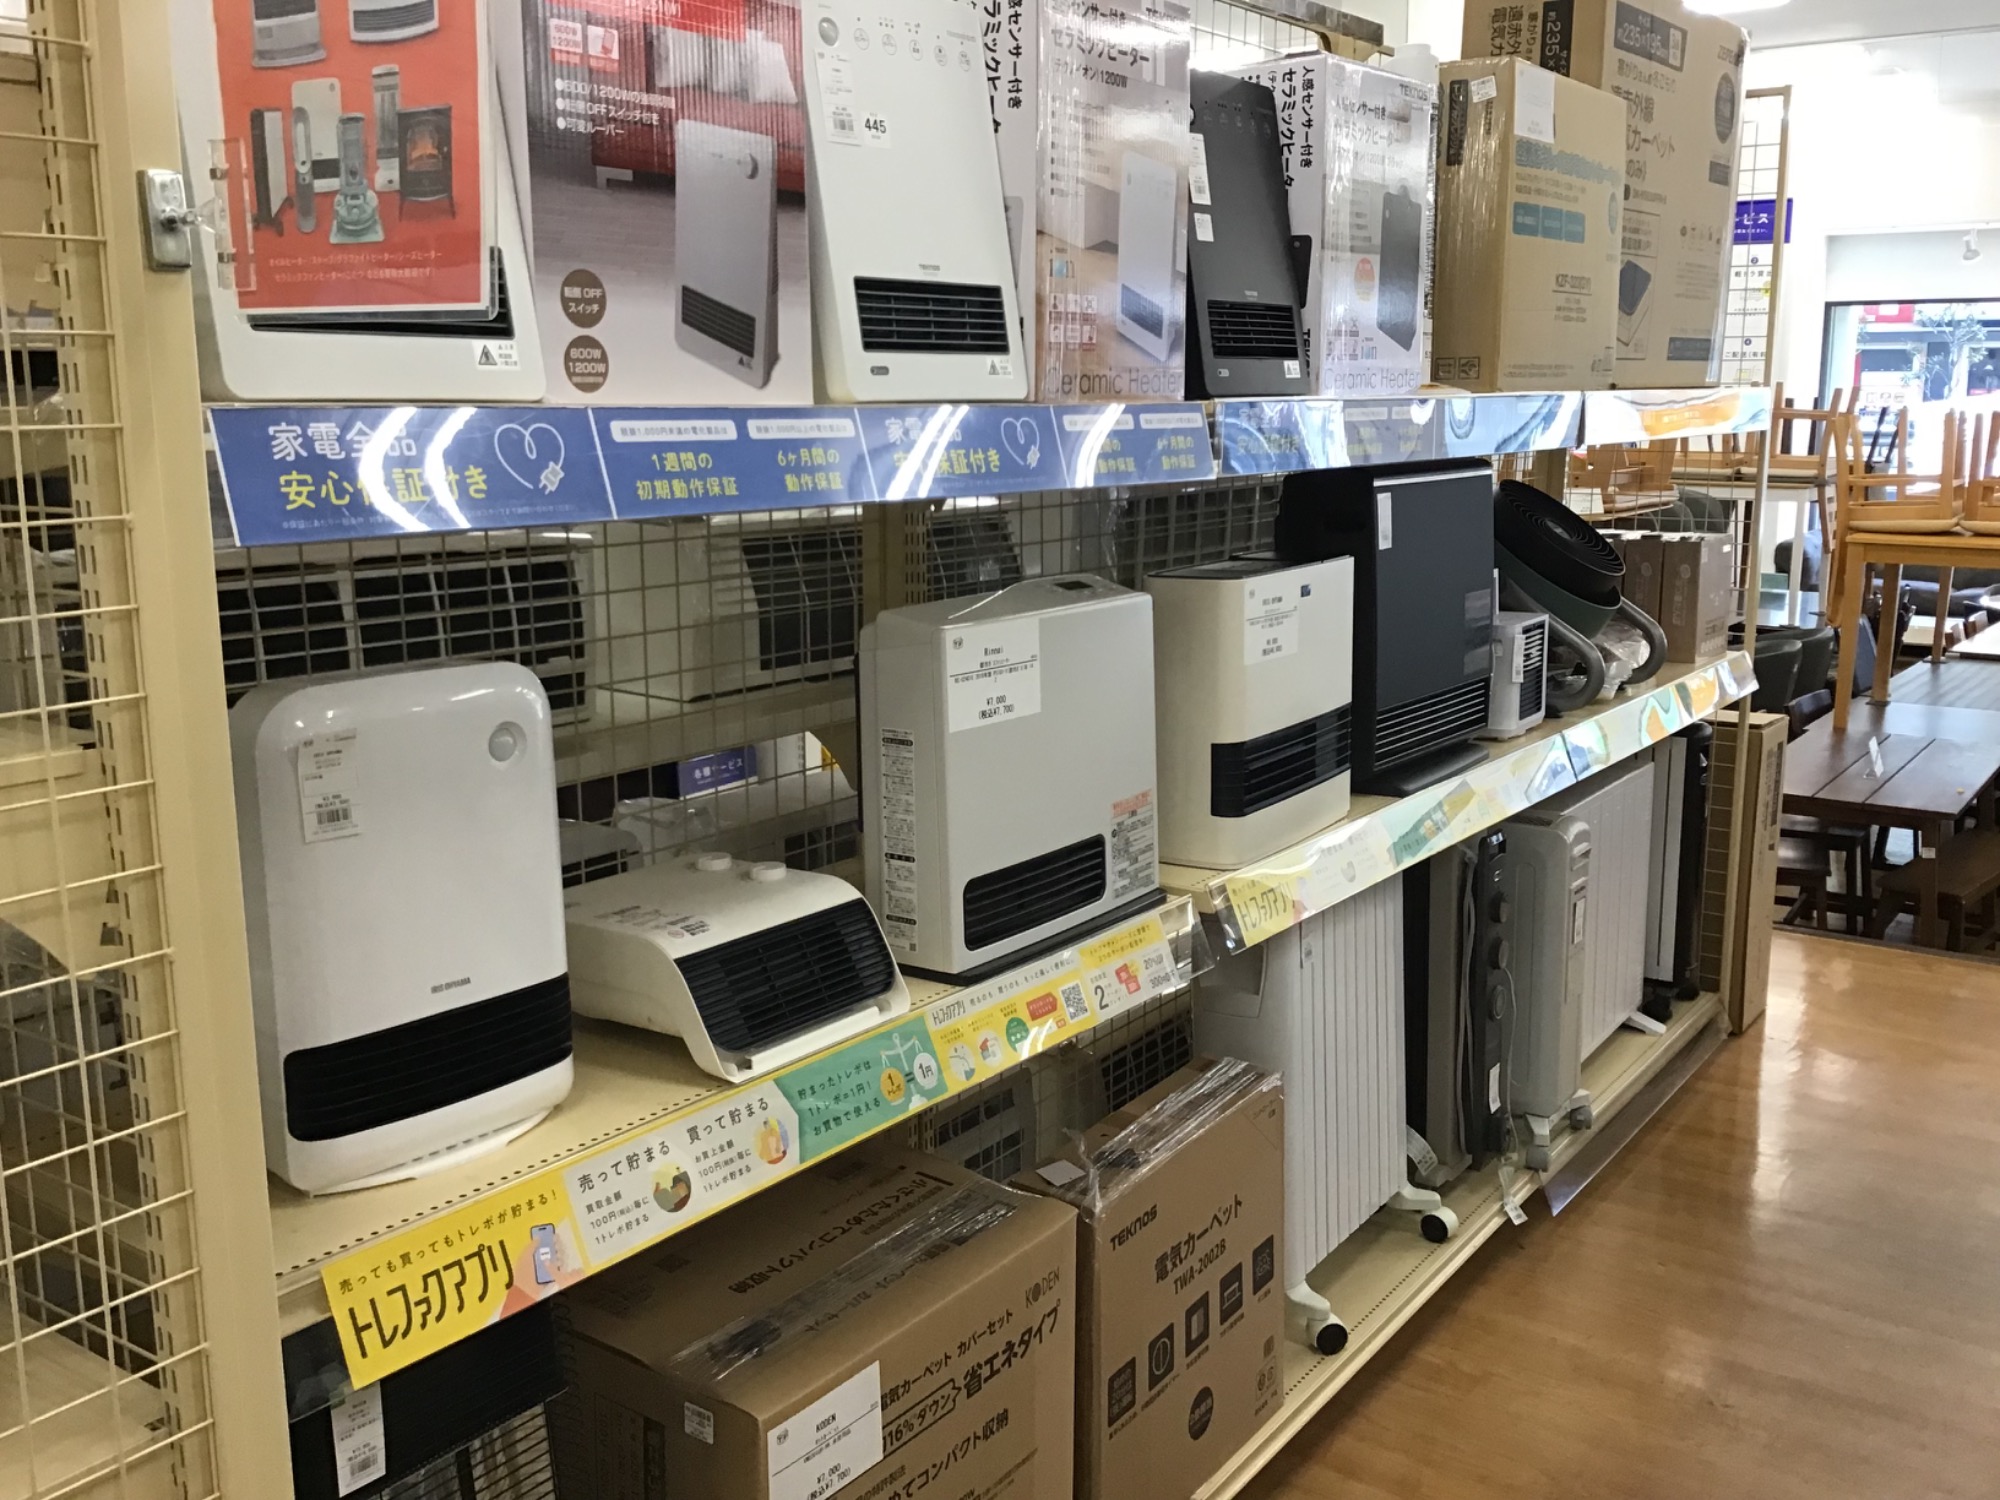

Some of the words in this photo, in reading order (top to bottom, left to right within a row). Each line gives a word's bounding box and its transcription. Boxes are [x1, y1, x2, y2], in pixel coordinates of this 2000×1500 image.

[865, 117, 887, 134] 445
[568, 302, 600, 314] スイッチ
[570, 348, 602, 360] 600W
[568, 361, 607, 374] 1200W
[1323, 366, 1377, 390] Ceramic
[1380, 368, 1421, 389] Heater
[1047, 365, 1123, 396] Ceramic
[1128, 367, 1183, 394] Heater
[651, 452, 714, 472] 1週間の
[777, 448, 840, 467] 6ヶ月間の
[636, 477, 740, 501] 初期動作保証
[784, 472, 844, 493] 動作保証
[1094, 985, 1110, 1010] 2
[797, 1060, 872, 1100] 貯まったトレポは
[887, 1073, 895, 1086] 1
[919, 1063, 934, 1079] 1円
[686, 1098, 769, 1145] 買って貯まる
[813, 1098, 881, 1136] お買物で使える
[695, 1139, 735, 1164] お買上金額
[577, 1141, 670, 1194] 売って貯まる
[703, 1164, 752, 1193] 1トレポ貯まる
[585, 1190, 622, 1215] 買取金額
[595, 1214, 649, 1244] 1トレポ貯まる
[1109, 1204, 1158, 1250] TEKNOS
[1155, 1193, 1243, 1284] 電気カーペット
[1173, 1238, 1226, 1295] TWA-2002B
[956, 1308, 1013, 1359] カバーセット
[962, 1298, 1061, 1399] 省エネタイプ
